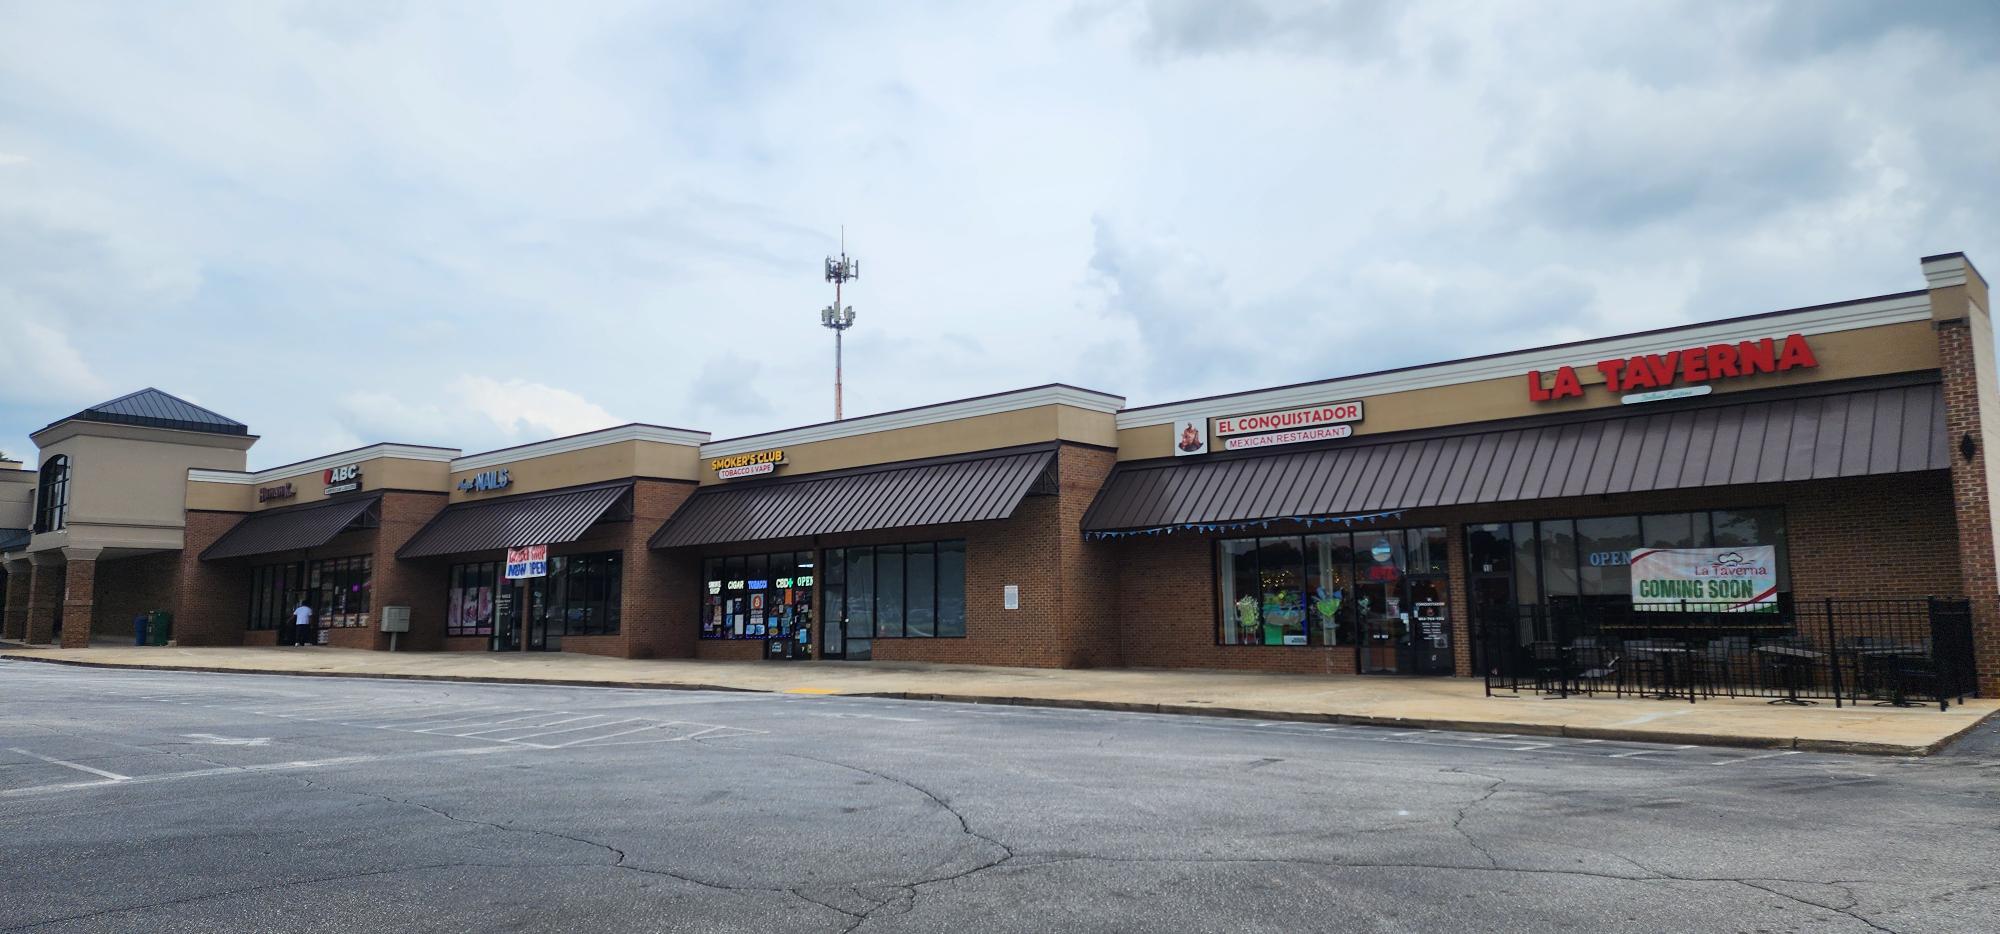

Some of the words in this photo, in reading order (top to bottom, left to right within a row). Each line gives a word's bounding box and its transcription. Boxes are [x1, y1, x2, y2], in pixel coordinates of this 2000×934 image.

[1528, 366, 1584, 401] LA
[1597, 333, 1819, 393] TAVERNA
[1219, 421, 1235, 433] EL
[1239, 405, 1358, 431] CONQUISTADOR
[1229, 435, 1273, 448] MEXICAN
[1277, 427, 1346, 442] RESTAURANT
[711, 455, 756, 470] SMOKER'S
[758, 450, 784, 463] CLUB
[330, 464, 359, 483] ABC
[476, 468, 510, 491] NAILS
[722, 467, 749, 477] TOBACCO
[755, 464, 772, 472] VAPE
[1590, 552, 1632, 567] OPEN
[508, 563, 527, 577] NOW
[1694, 565, 1709, 576] La
[1712, 563, 1767, 576] Taverna
[728, 580, 744, 589] CIGAR
[1639, 579, 1704, 599] COMING
[1708, 579, 1753, 599] SOON
